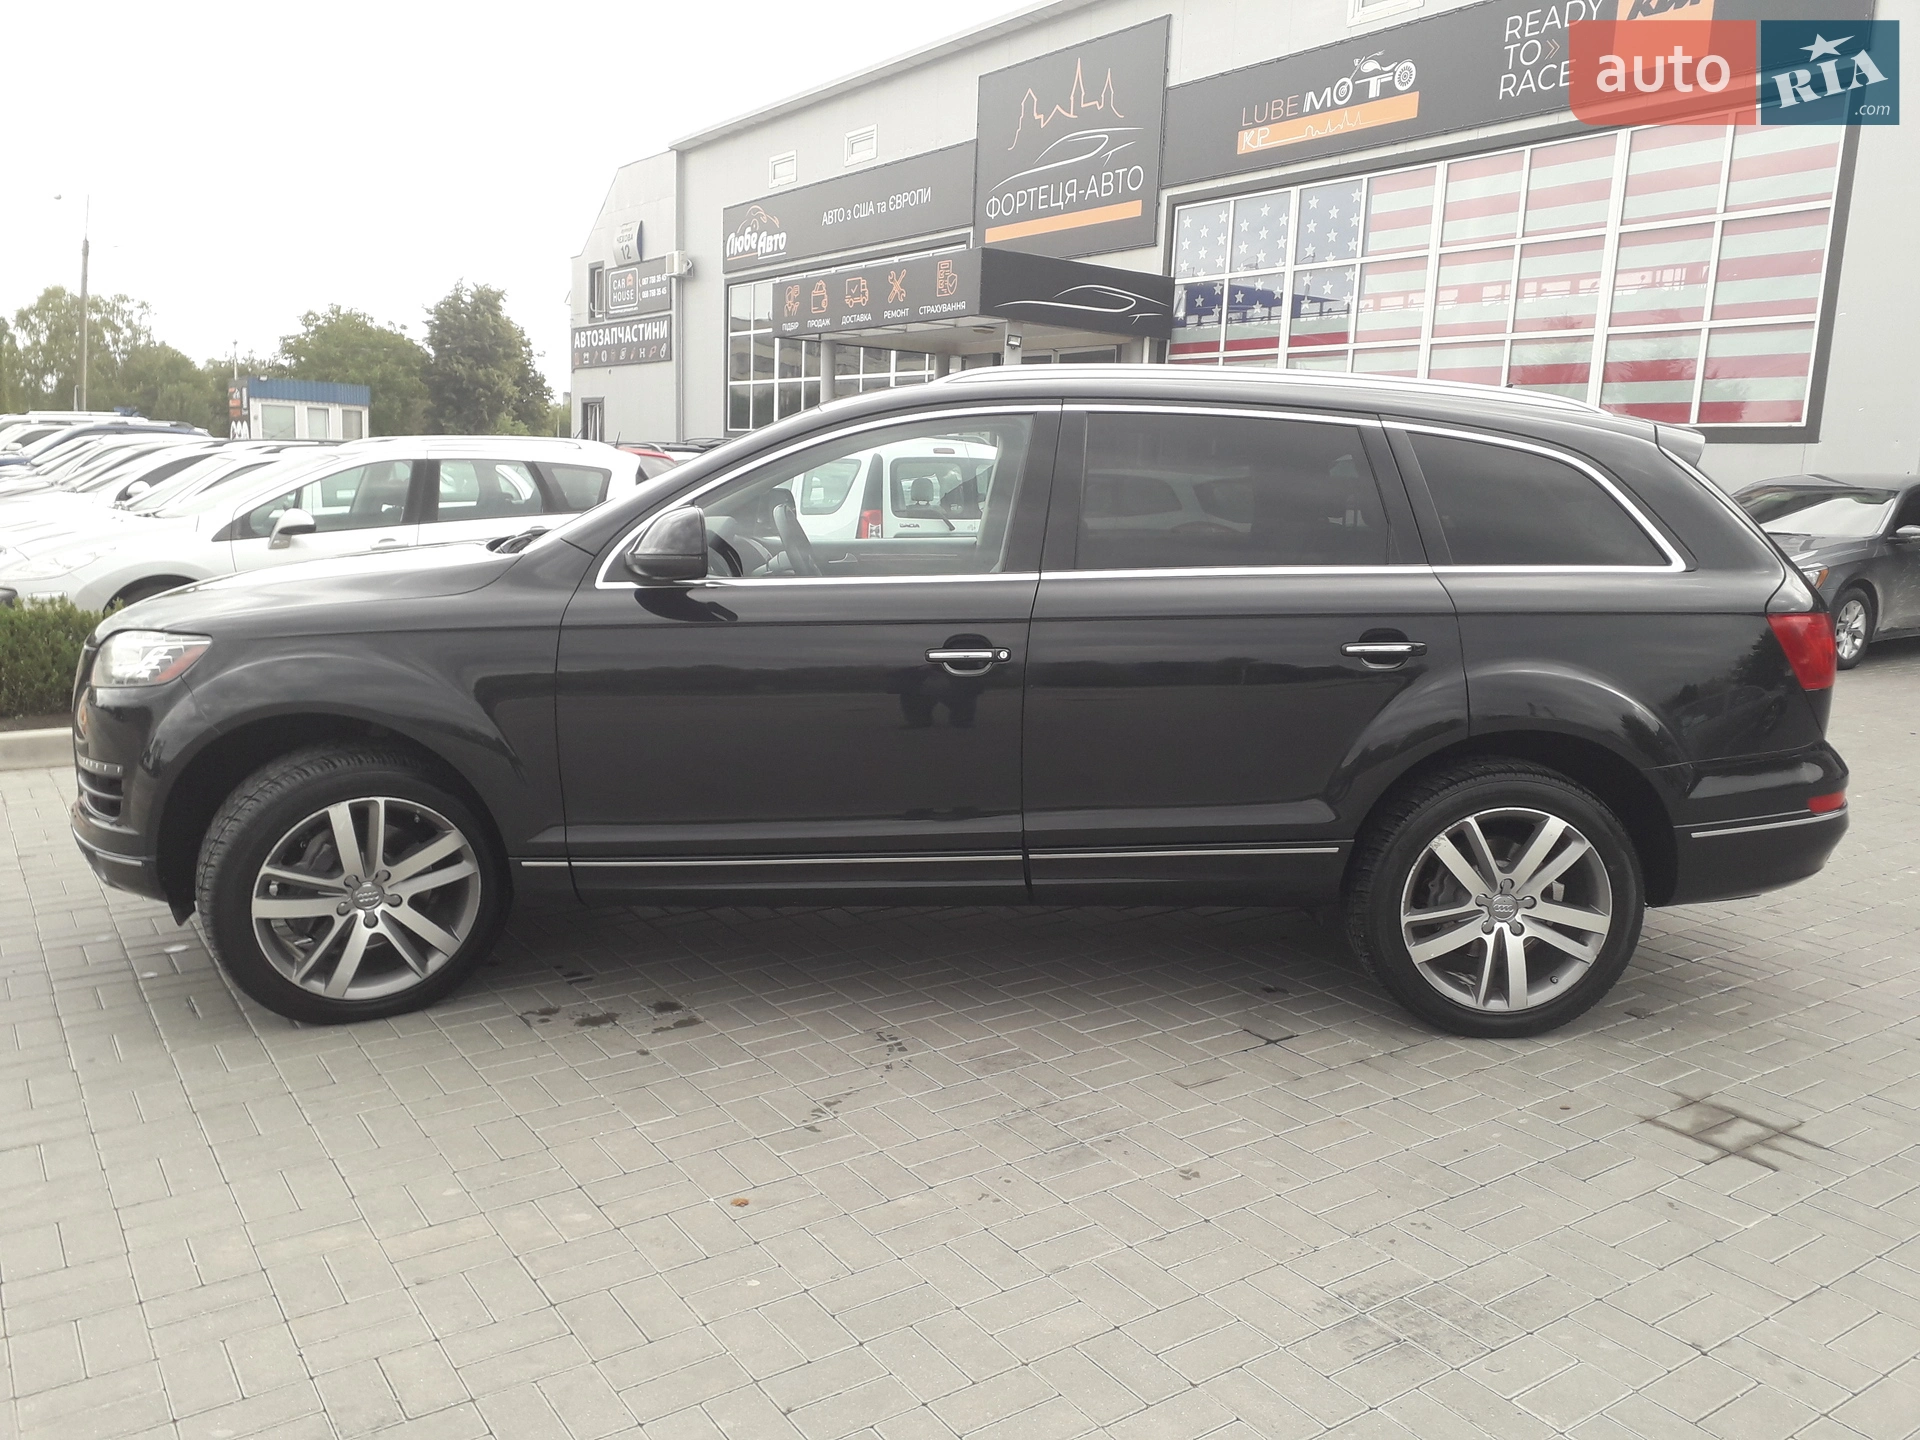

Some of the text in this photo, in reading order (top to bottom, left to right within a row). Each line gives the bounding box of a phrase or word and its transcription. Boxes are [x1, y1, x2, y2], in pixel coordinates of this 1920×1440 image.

[1504, 0, 1602, 42] READY
[1504, 39, 1541, 69] TO
[1242, 59, 1416, 126] LUBE MOTO
[1499, 59, 1576, 100] RACE
[822, 207, 845, 226] АВТО
[853, 201, 874, 219] США
[877, 202, 887, 214] та
[889, 186, 932, 210] ЄВРОПИ
[986, 165, 1144, 219] ФОРТЕЦЯ-АВТО
[621, 244, 632, 260] 12
[613, 278, 626, 290] CAR
[613, 289, 634, 302] HOUSE
[782, 301, 966, 331] ПІДБІР ПРОДАЖ ДОСТАВКА РЕМОНТ СТРАХУВАННЯ
[574, 320, 668, 349] АВТОЗАПЧАСТИНИ
